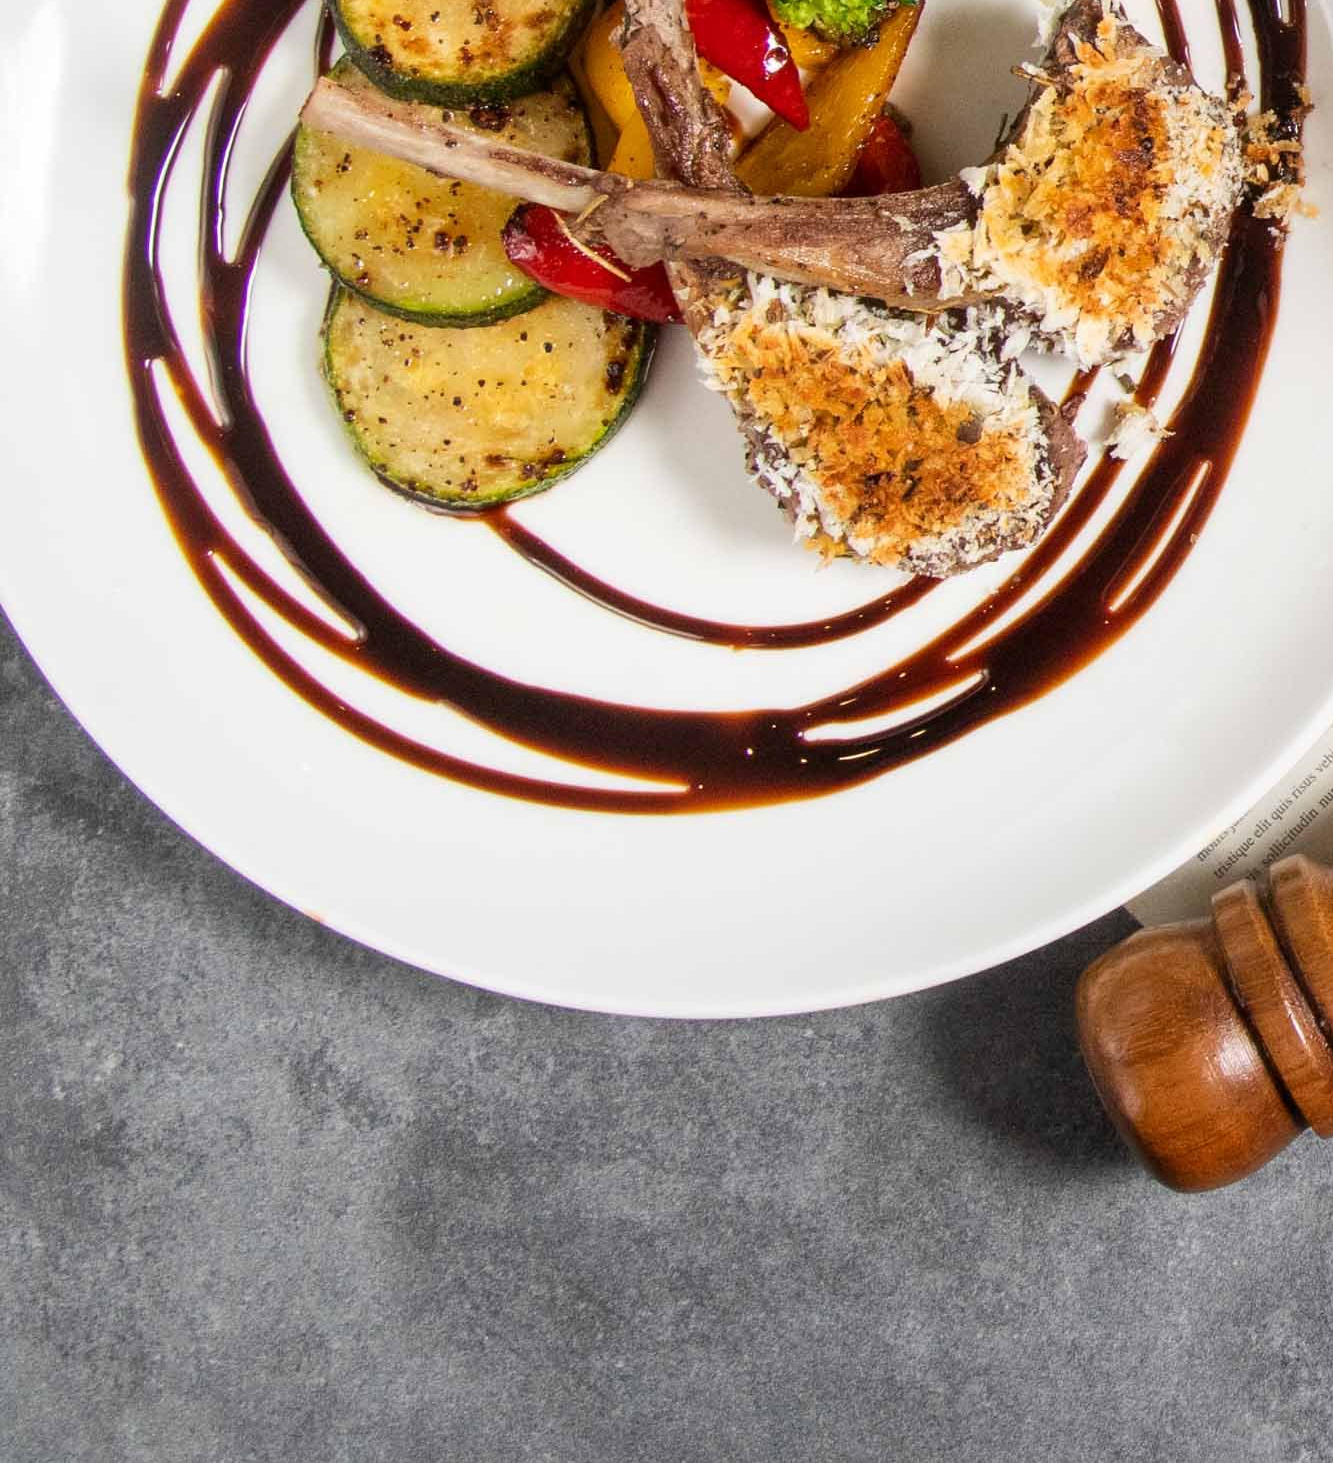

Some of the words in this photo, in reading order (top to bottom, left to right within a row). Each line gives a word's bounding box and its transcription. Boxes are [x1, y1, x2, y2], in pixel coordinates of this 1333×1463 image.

[1212, 835, 1257, 880] tristique
[1252, 818, 1274, 840] elit
[1269, 796, 1295, 822] quis
[1290, 772, 1319, 801] risus
[1260, 806, 1320, 868] sollicitudin
